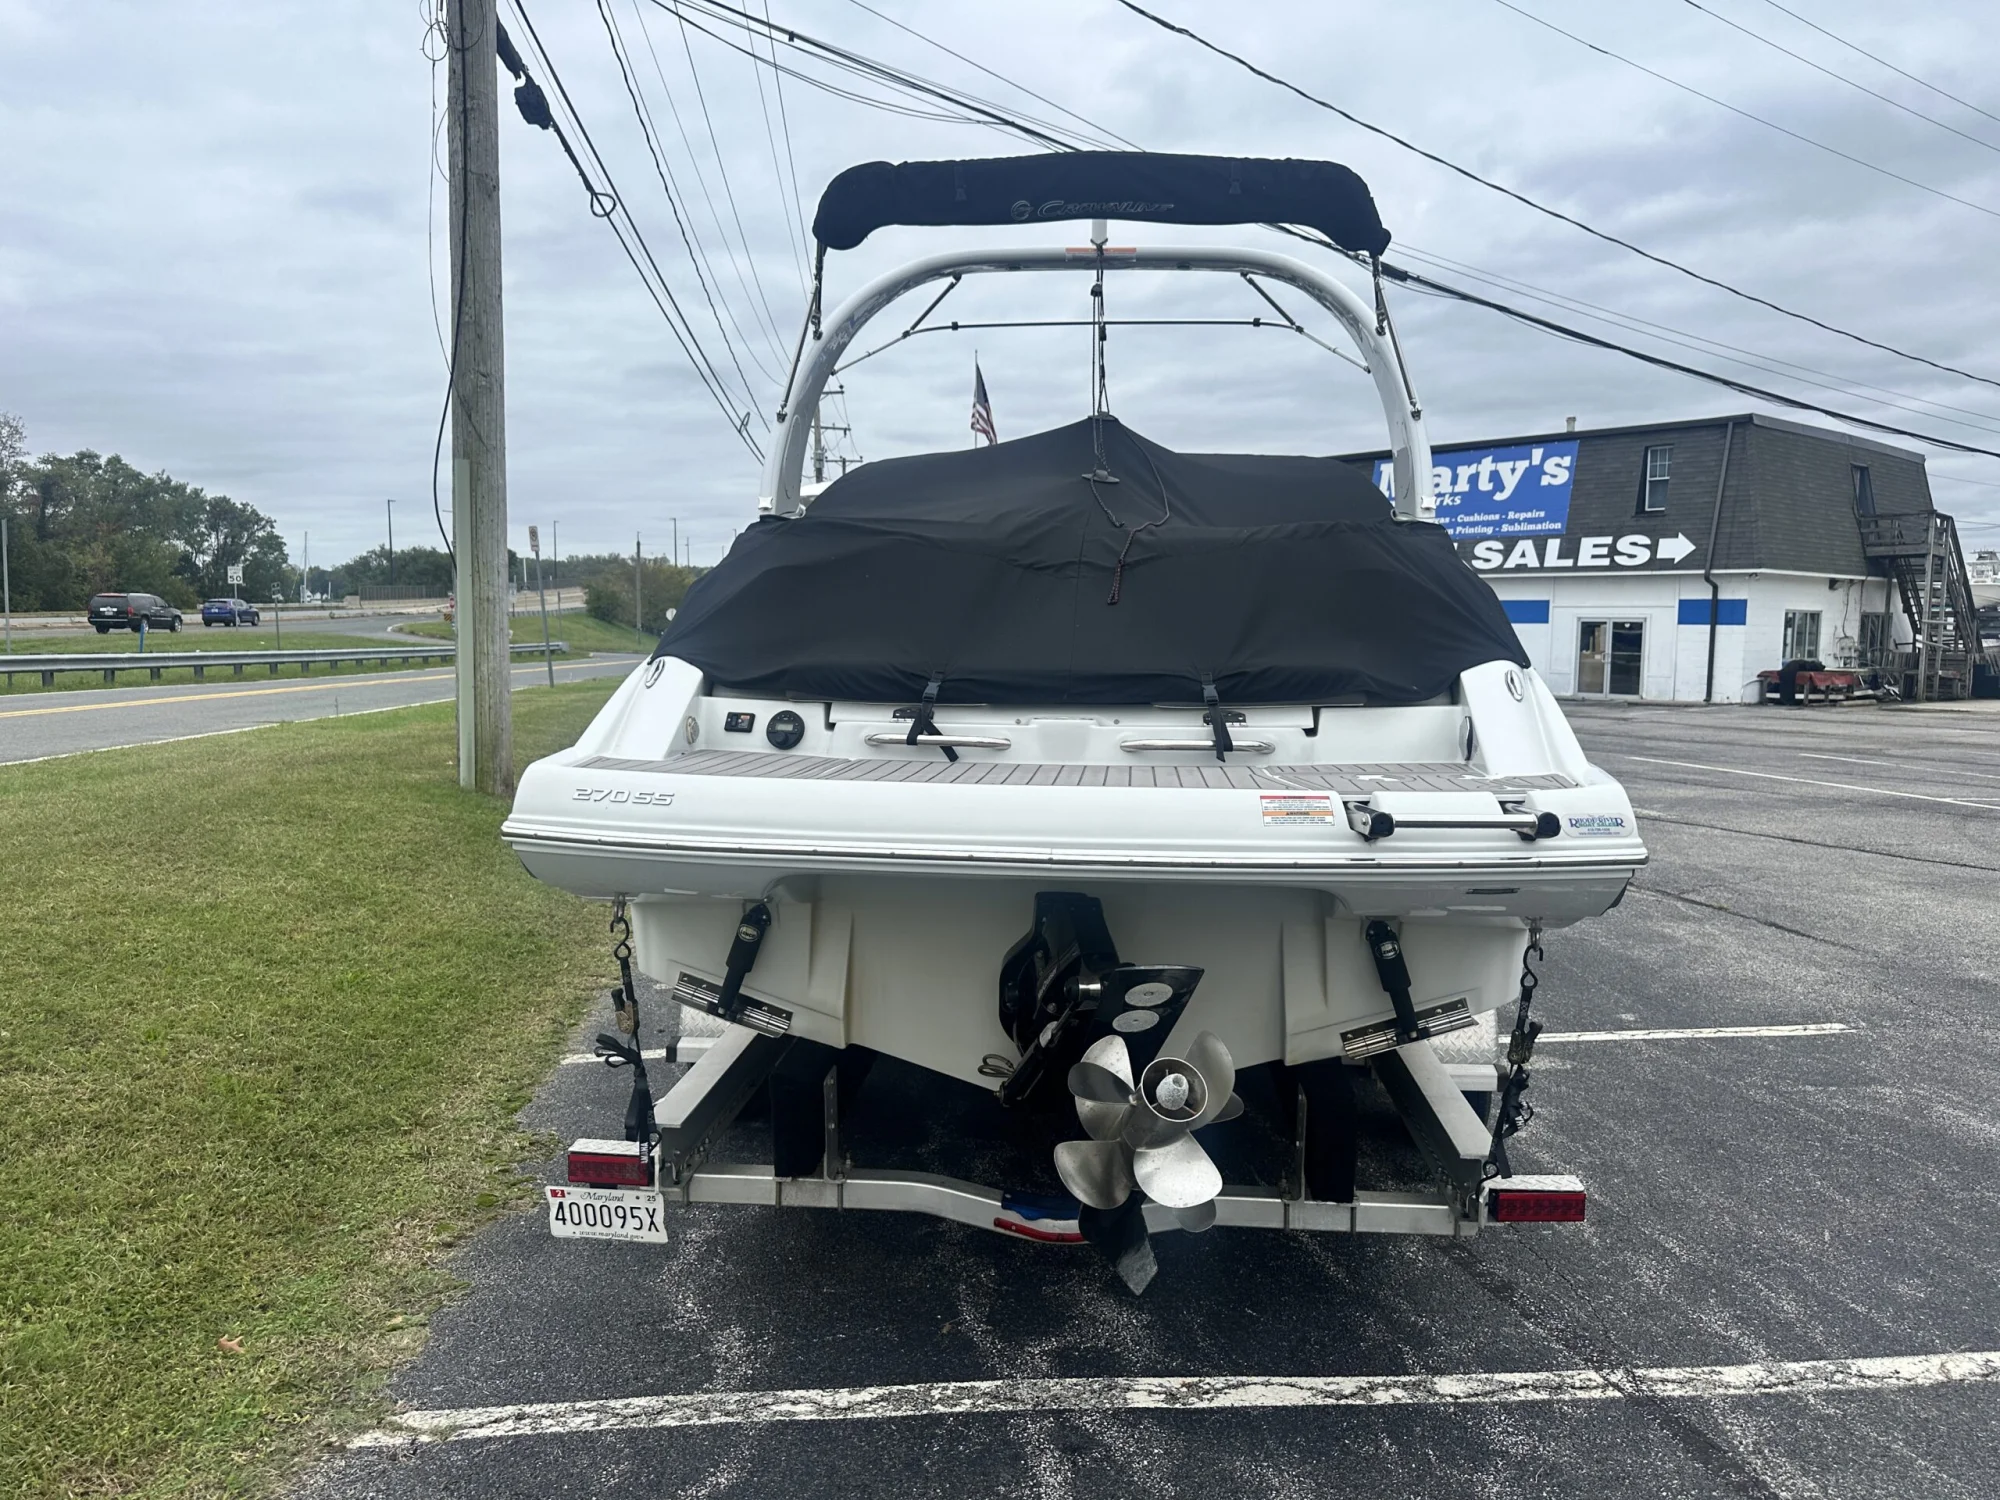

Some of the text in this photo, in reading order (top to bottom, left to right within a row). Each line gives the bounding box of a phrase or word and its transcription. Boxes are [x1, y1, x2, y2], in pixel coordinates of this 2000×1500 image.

[1435, 493, 1461, 506] rks
[1457, 513, 1500, 522] Cushions
[1507, 509, 1545, 520] Repairs
[1456, 524, 1493, 535] Printing
[1501, 521, 1561, 532] Sublimation
[1471, 534, 1651, 569] SALES
[572, 788, 675, 806] 270 SS
[580, 1191, 625, 1204] Maryland
[646, 1194, 656, 1202] 25
[555, 1201, 660, 1233] 400095X
